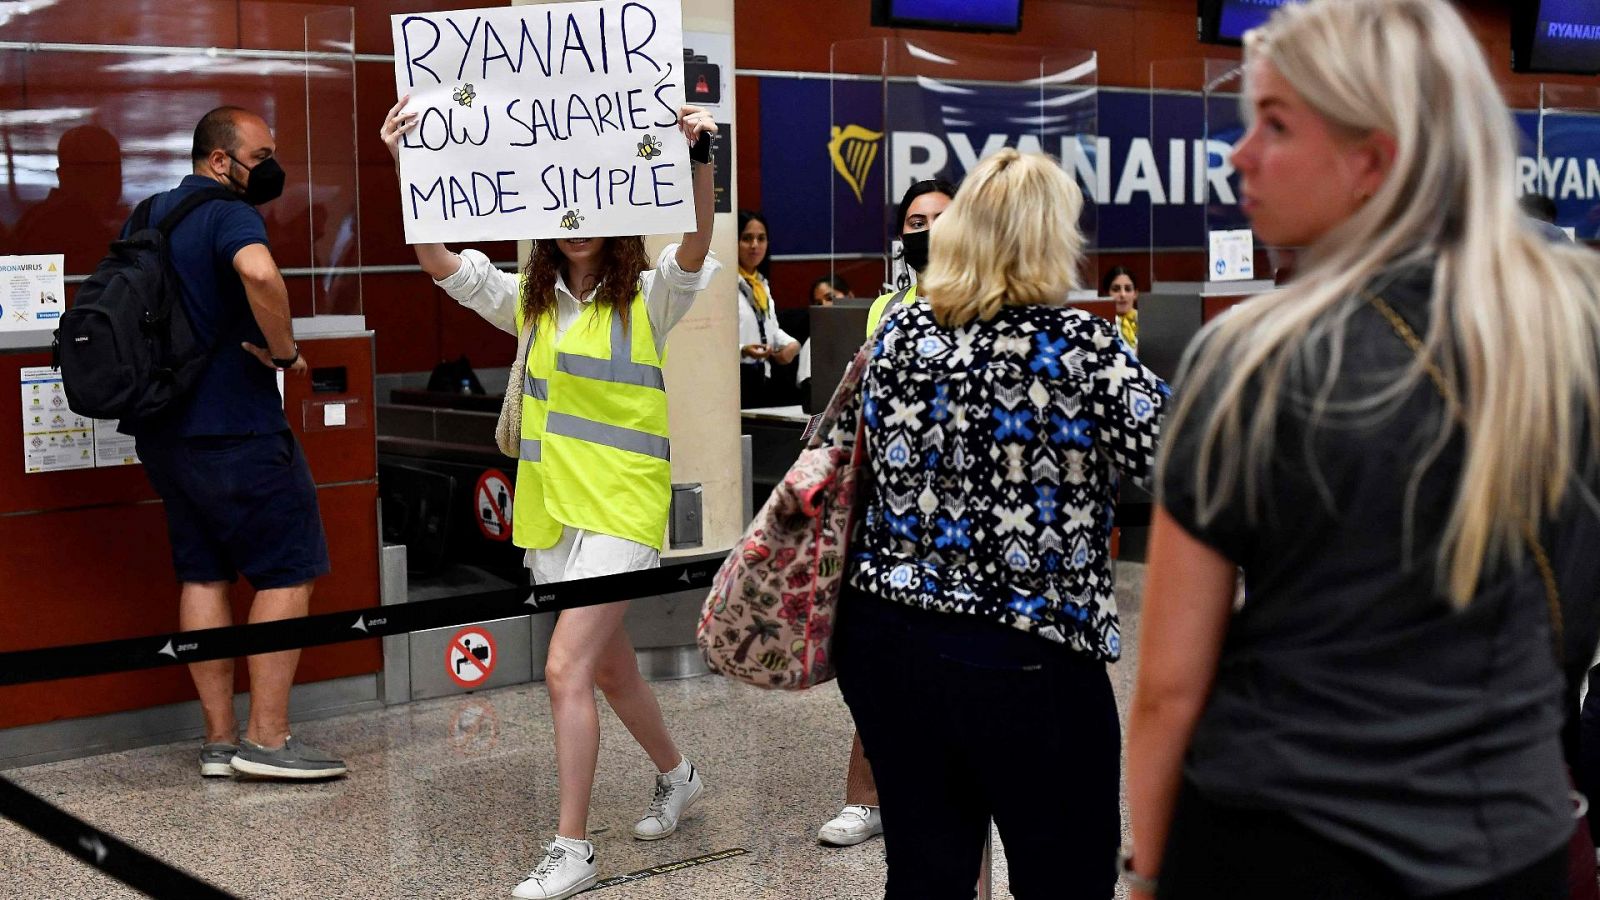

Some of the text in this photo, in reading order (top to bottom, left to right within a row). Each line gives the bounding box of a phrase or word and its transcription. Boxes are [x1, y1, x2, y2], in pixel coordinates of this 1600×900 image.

[506, 84, 679, 146] SALARIES
[410, 164, 683, 220] MADE SIMPLE
[892, 131, 1237, 205] RYNAIR
[177, 643, 198, 651] aena
[367, 617, 387, 626] aena
